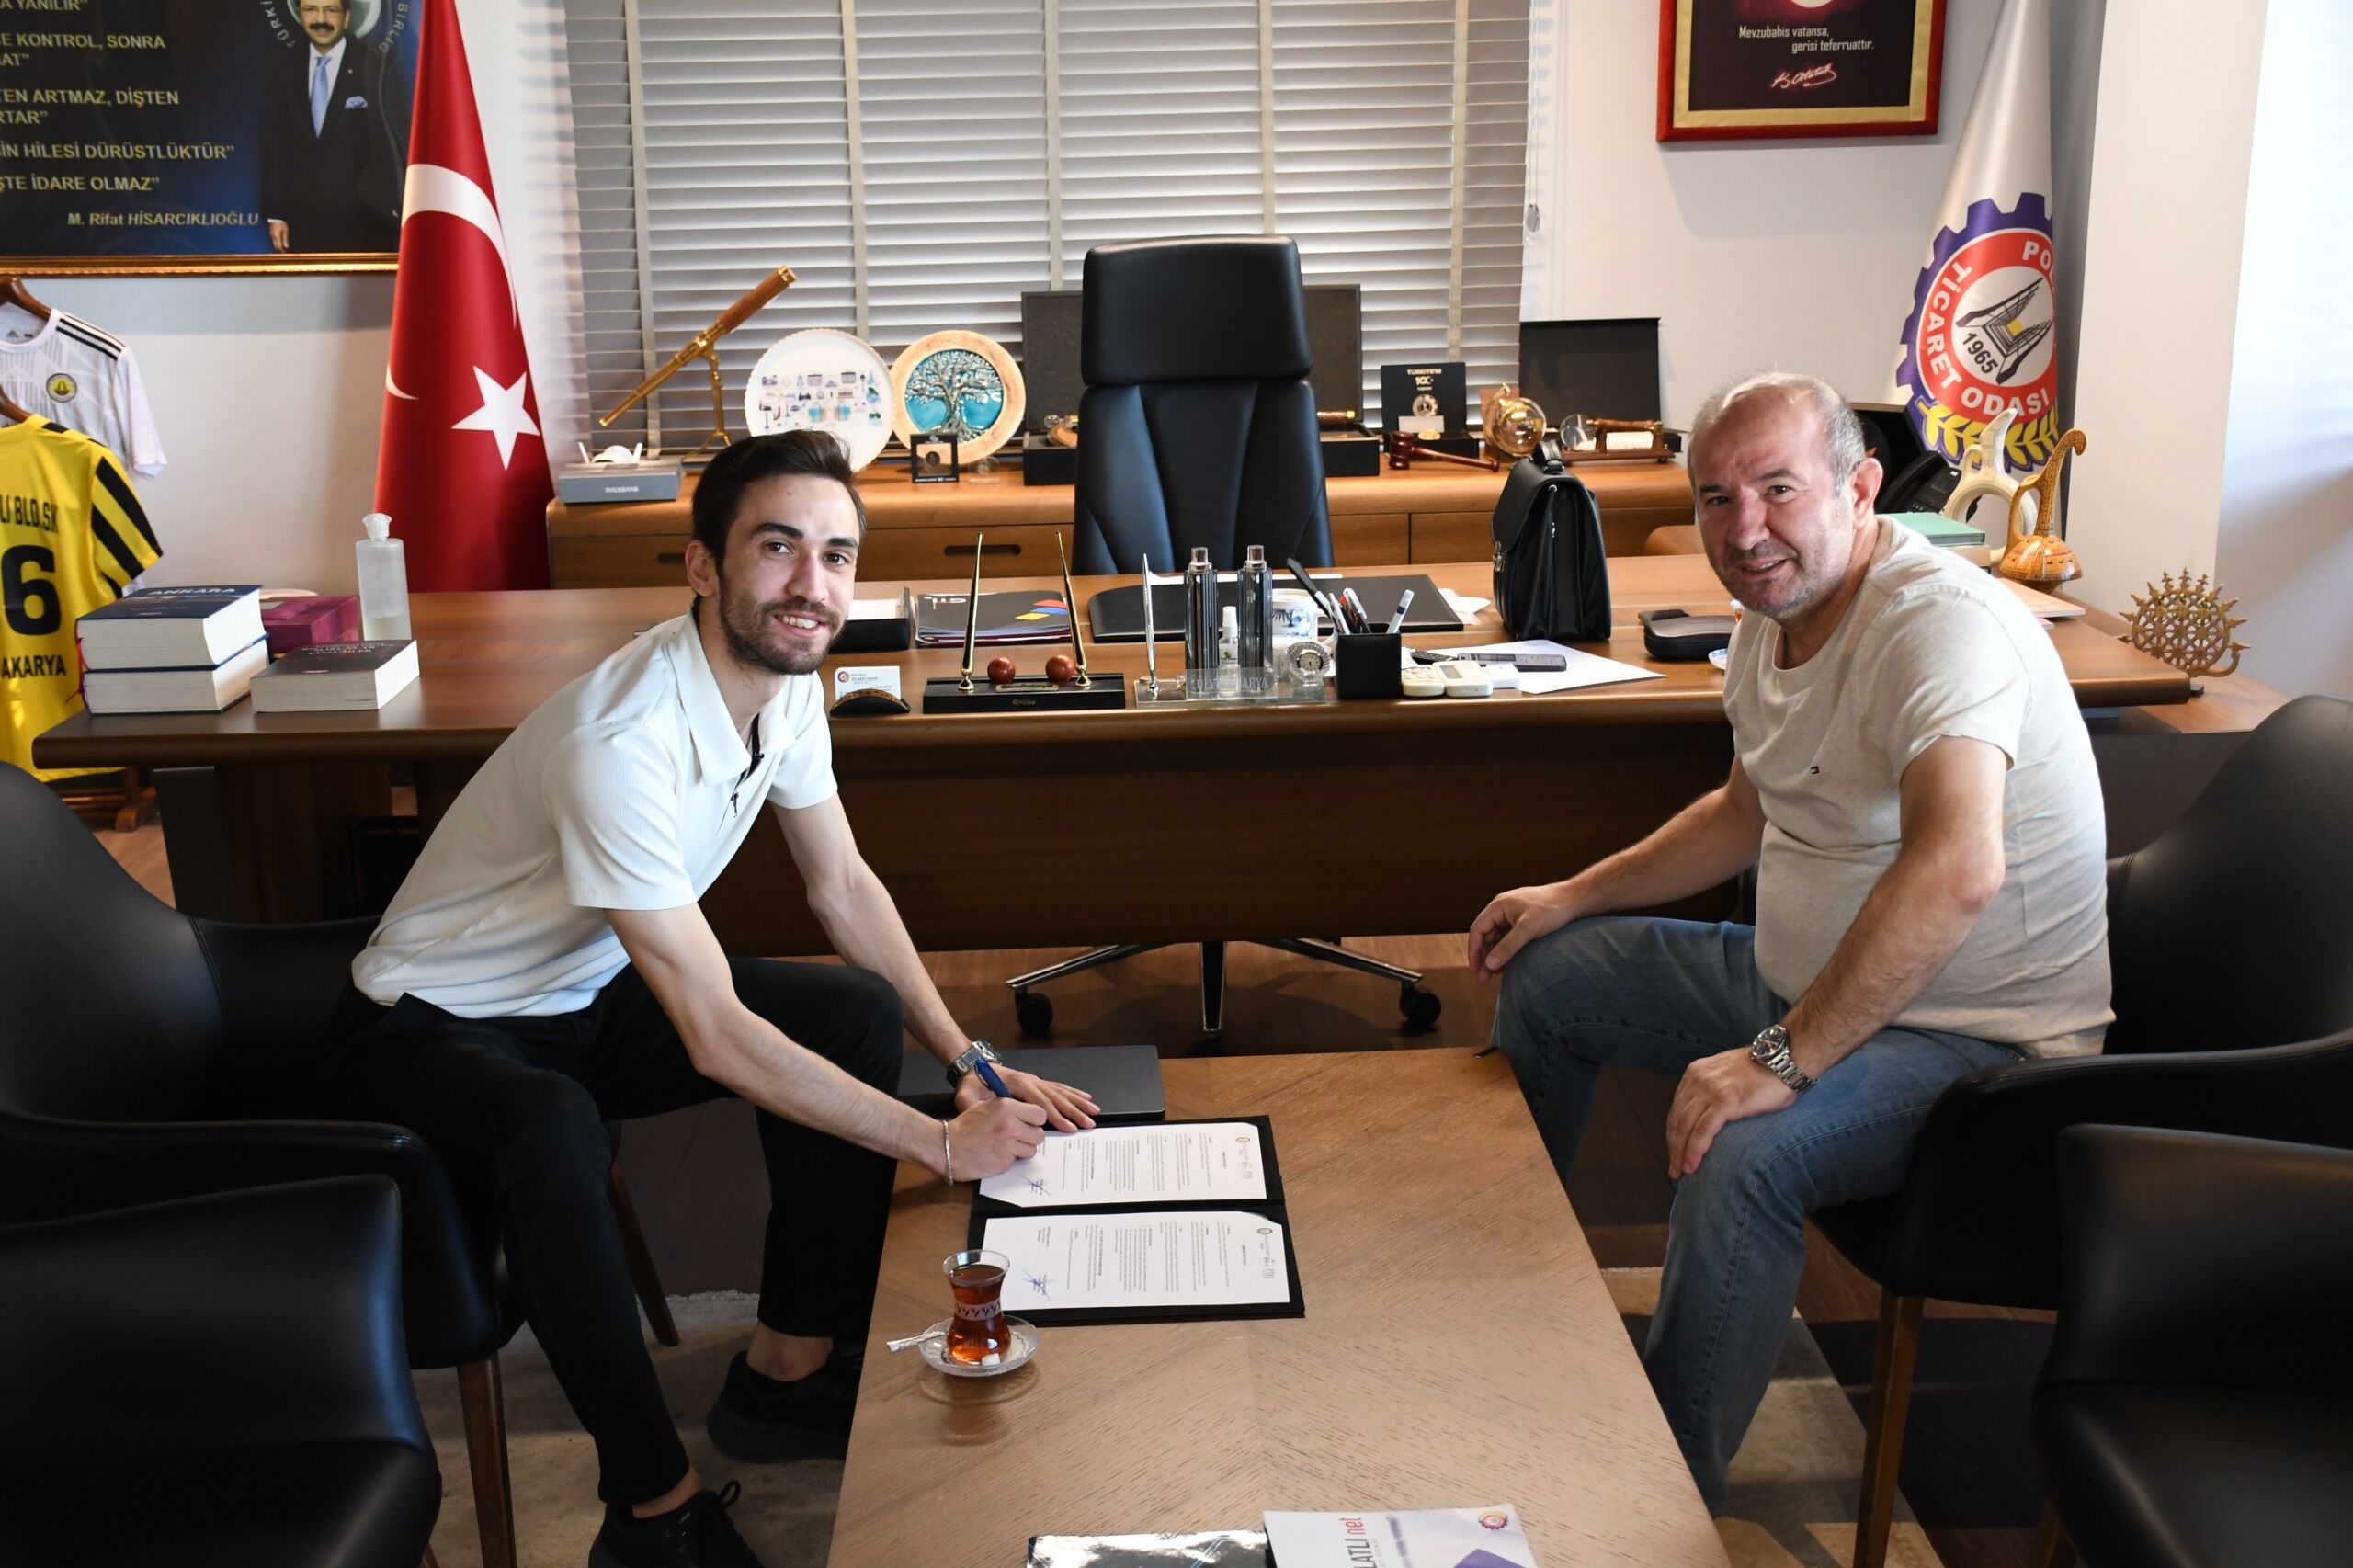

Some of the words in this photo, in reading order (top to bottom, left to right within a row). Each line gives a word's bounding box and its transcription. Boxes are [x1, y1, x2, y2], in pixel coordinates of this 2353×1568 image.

[1739, 25, 1790, 39] Mevzubahis
[17, 33, 103, 50] KONTROL,
[107, 35, 166, 49] SONRA
[1791, 40, 1818, 54] gerisi
[0, 52, 30, 66] AT”
[0, 89, 28, 103] EN
[33, 89, 112, 107] ARTMAZ,
[116, 86, 180, 108] DİŞTEN
[0, 141, 19, 157] İN
[24, 142, 81, 159] HİLESİ
[31, 173, 86, 190] İDARE
[68, 213, 85, 225] M.
[89, 212, 124, 225] Rifat
[127, 210, 259, 226] HİSARCIKLIOĞLU
[1927, 261, 1972, 390] TİCARET
[1961, 331, 1999, 374] 1965
[1961, 385, 2050, 417] ODASI
[2, 544, 62, 636] 6
